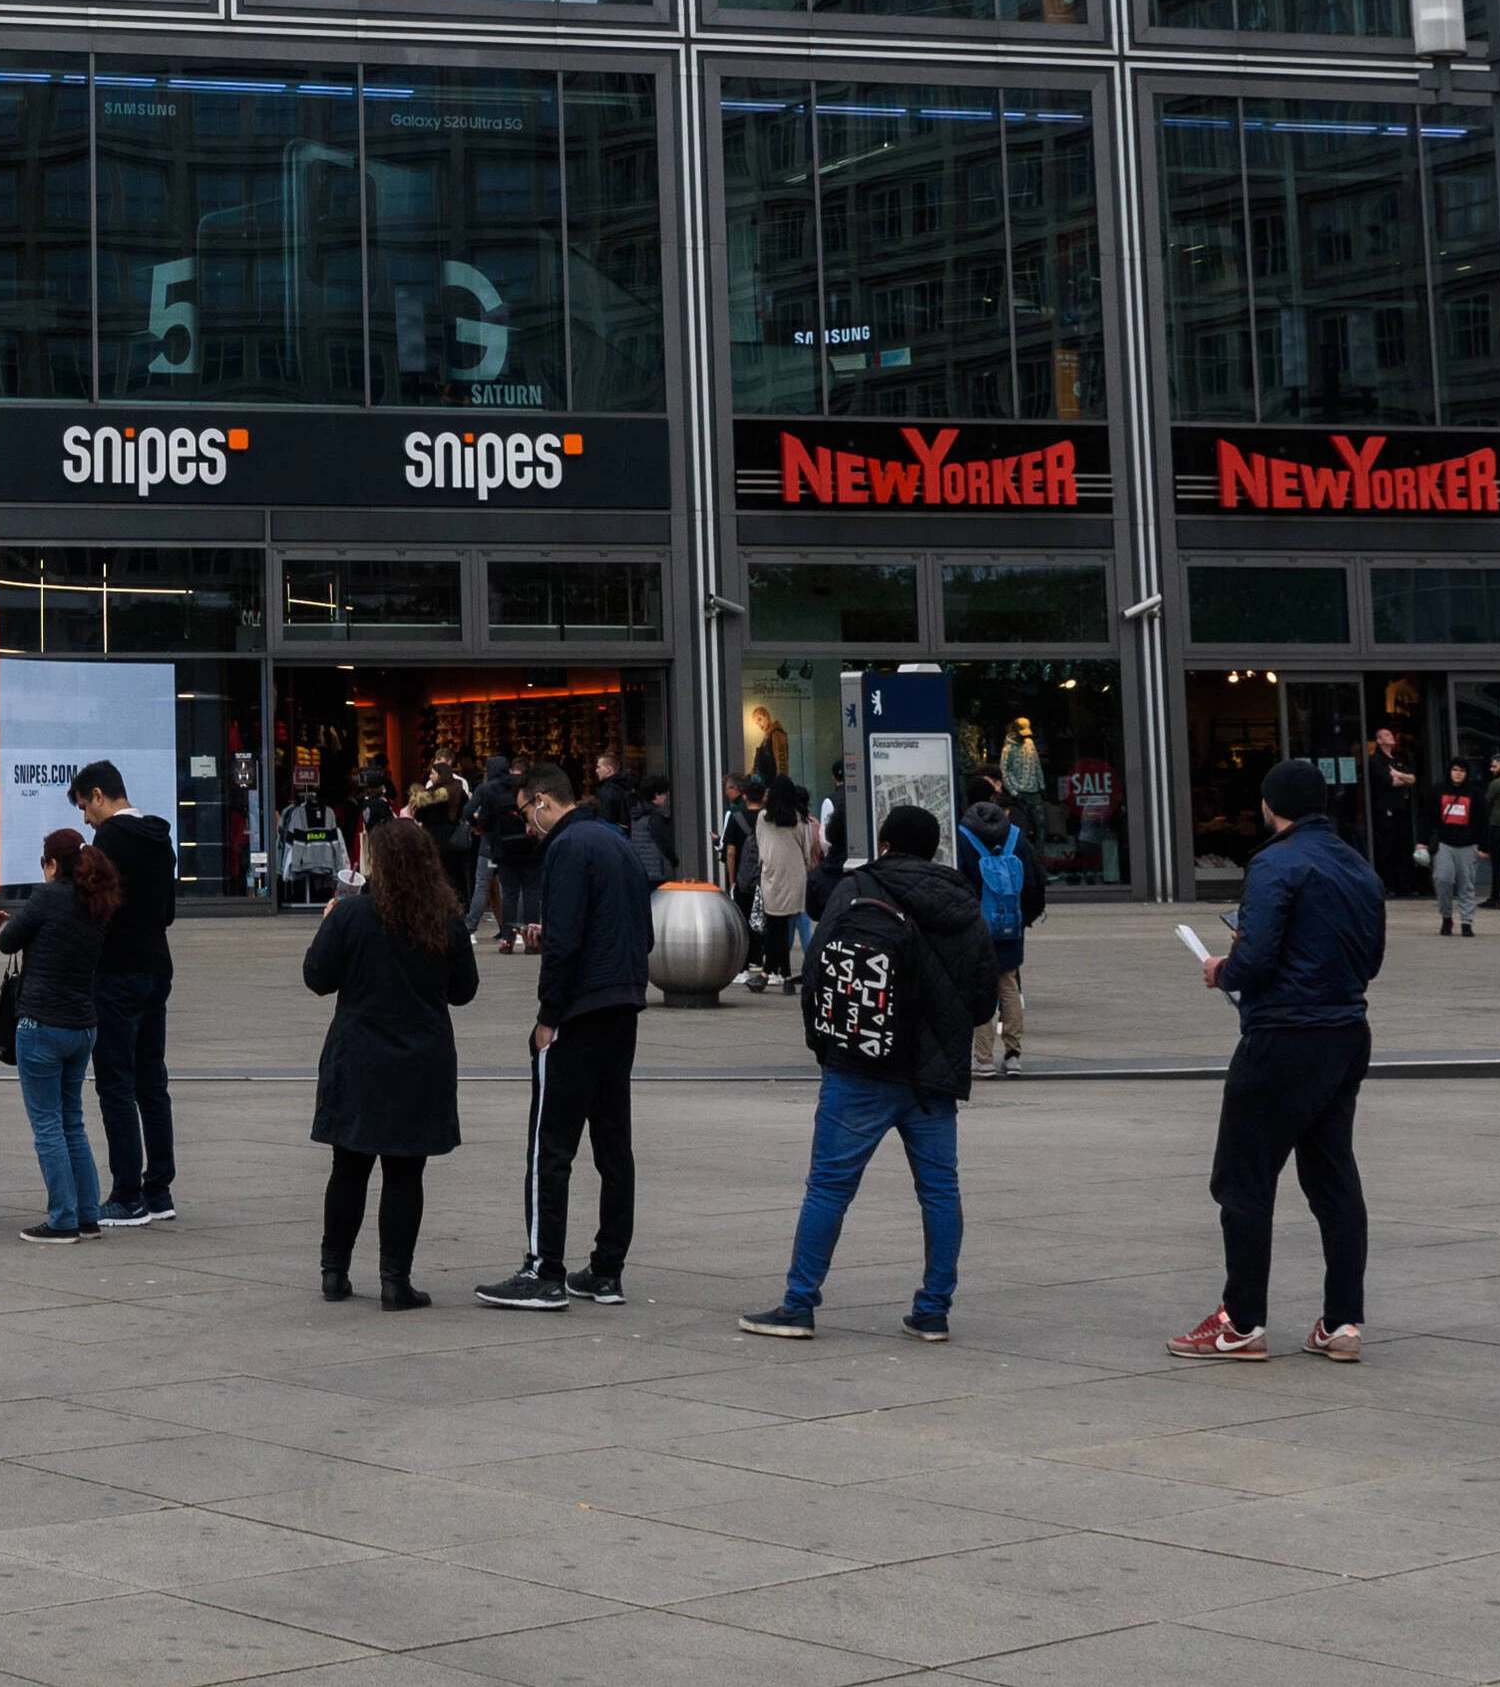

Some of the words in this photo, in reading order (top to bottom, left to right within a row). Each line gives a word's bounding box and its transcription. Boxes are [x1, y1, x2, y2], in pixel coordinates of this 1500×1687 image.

[104, 101, 177, 117] SAMSUNG
[390, 113, 441, 132] Galaxy
[443, 114, 467, 129] S20
[469, 116, 502, 130] Ultra
[504, 116, 523, 130] 5G
[147, 257, 196, 376] 5
[470, 384, 542, 408] SATURN
[62, 426, 227, 496] snipes
[404, 432, 562, 501] snipes
[872, 739, 919, 750] Alexanderplatz
[1071, 772, 1112, 794] SALE
